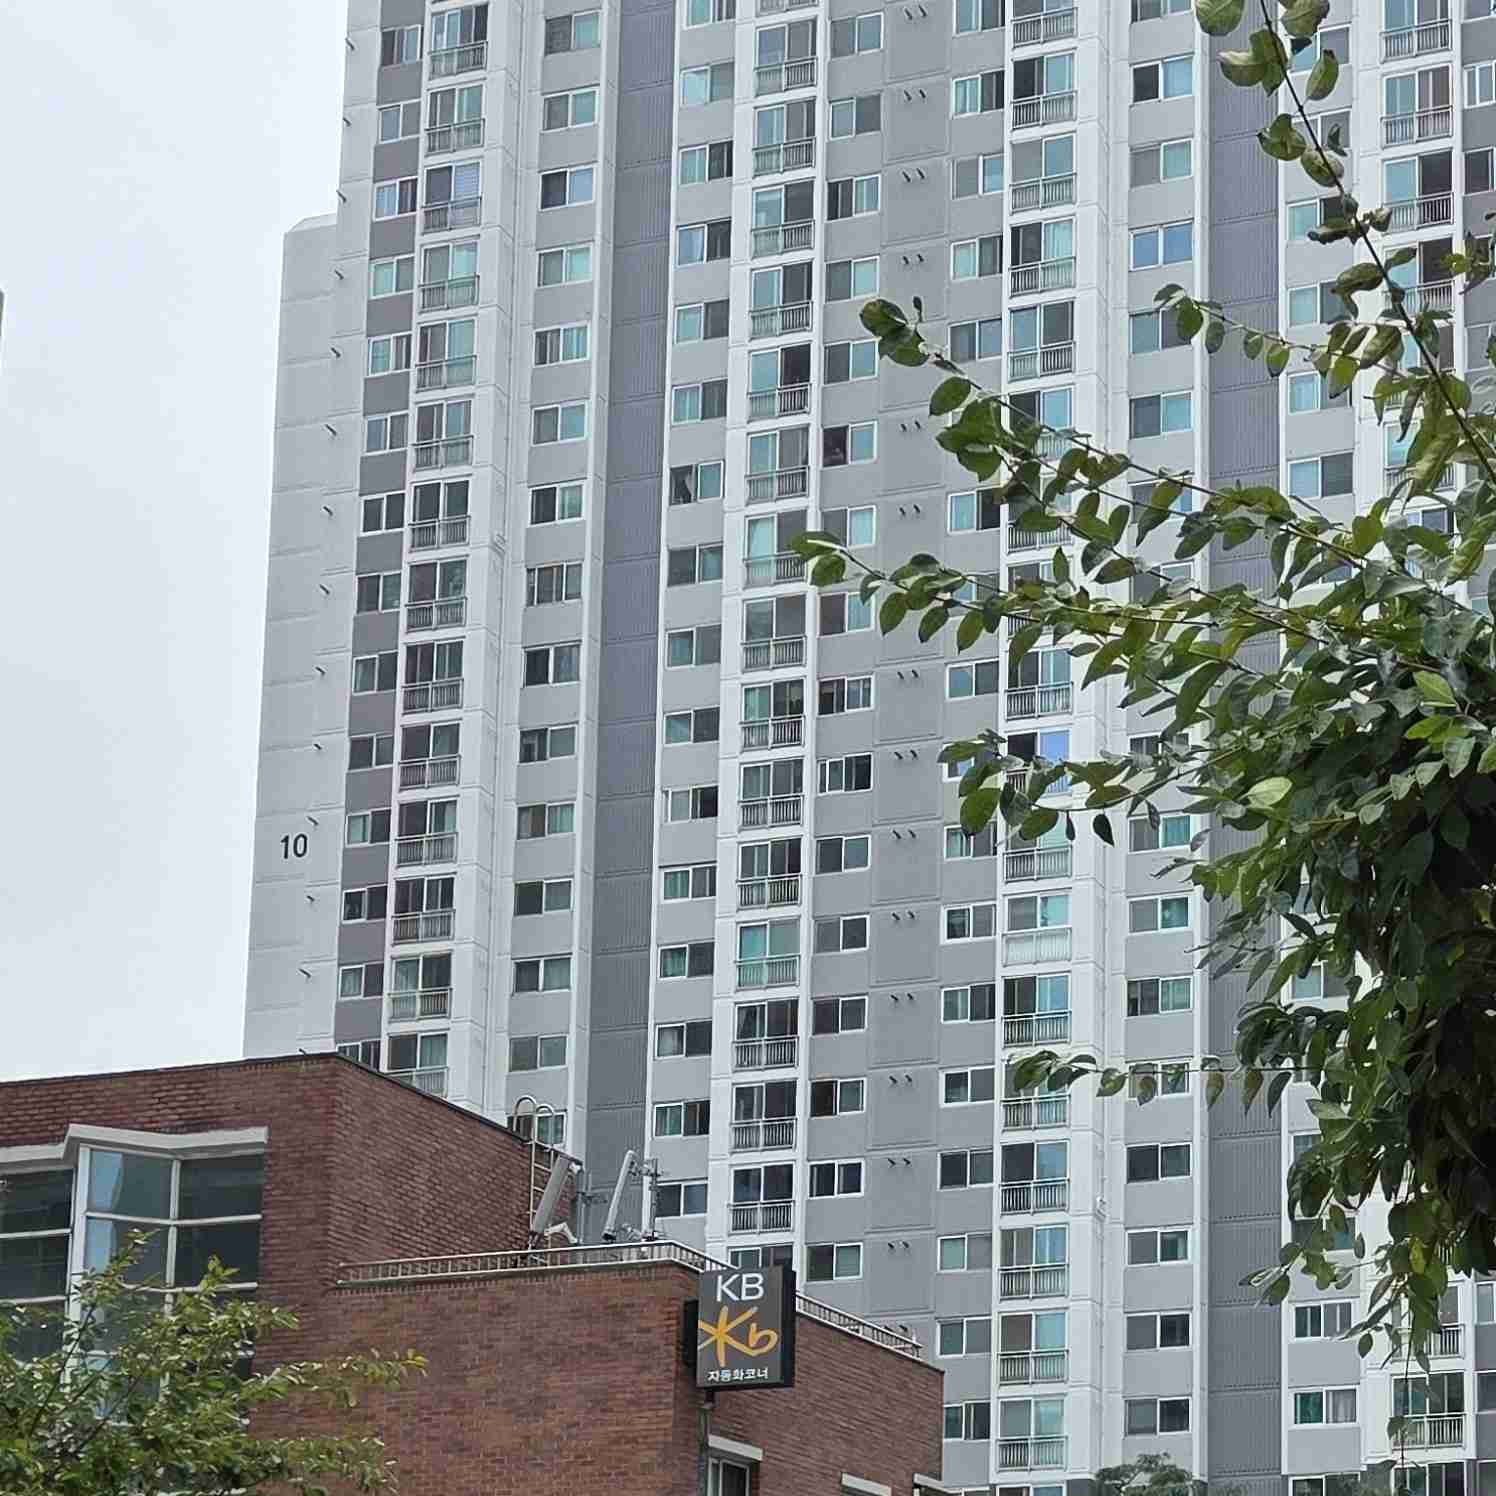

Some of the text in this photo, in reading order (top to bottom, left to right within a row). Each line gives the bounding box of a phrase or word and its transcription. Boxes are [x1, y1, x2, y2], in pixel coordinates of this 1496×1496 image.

[280, 833, 308, 859] 10
[716, 1272, 765, 1303] KB
[707, 1366, 769, 1383] 자동화코너
